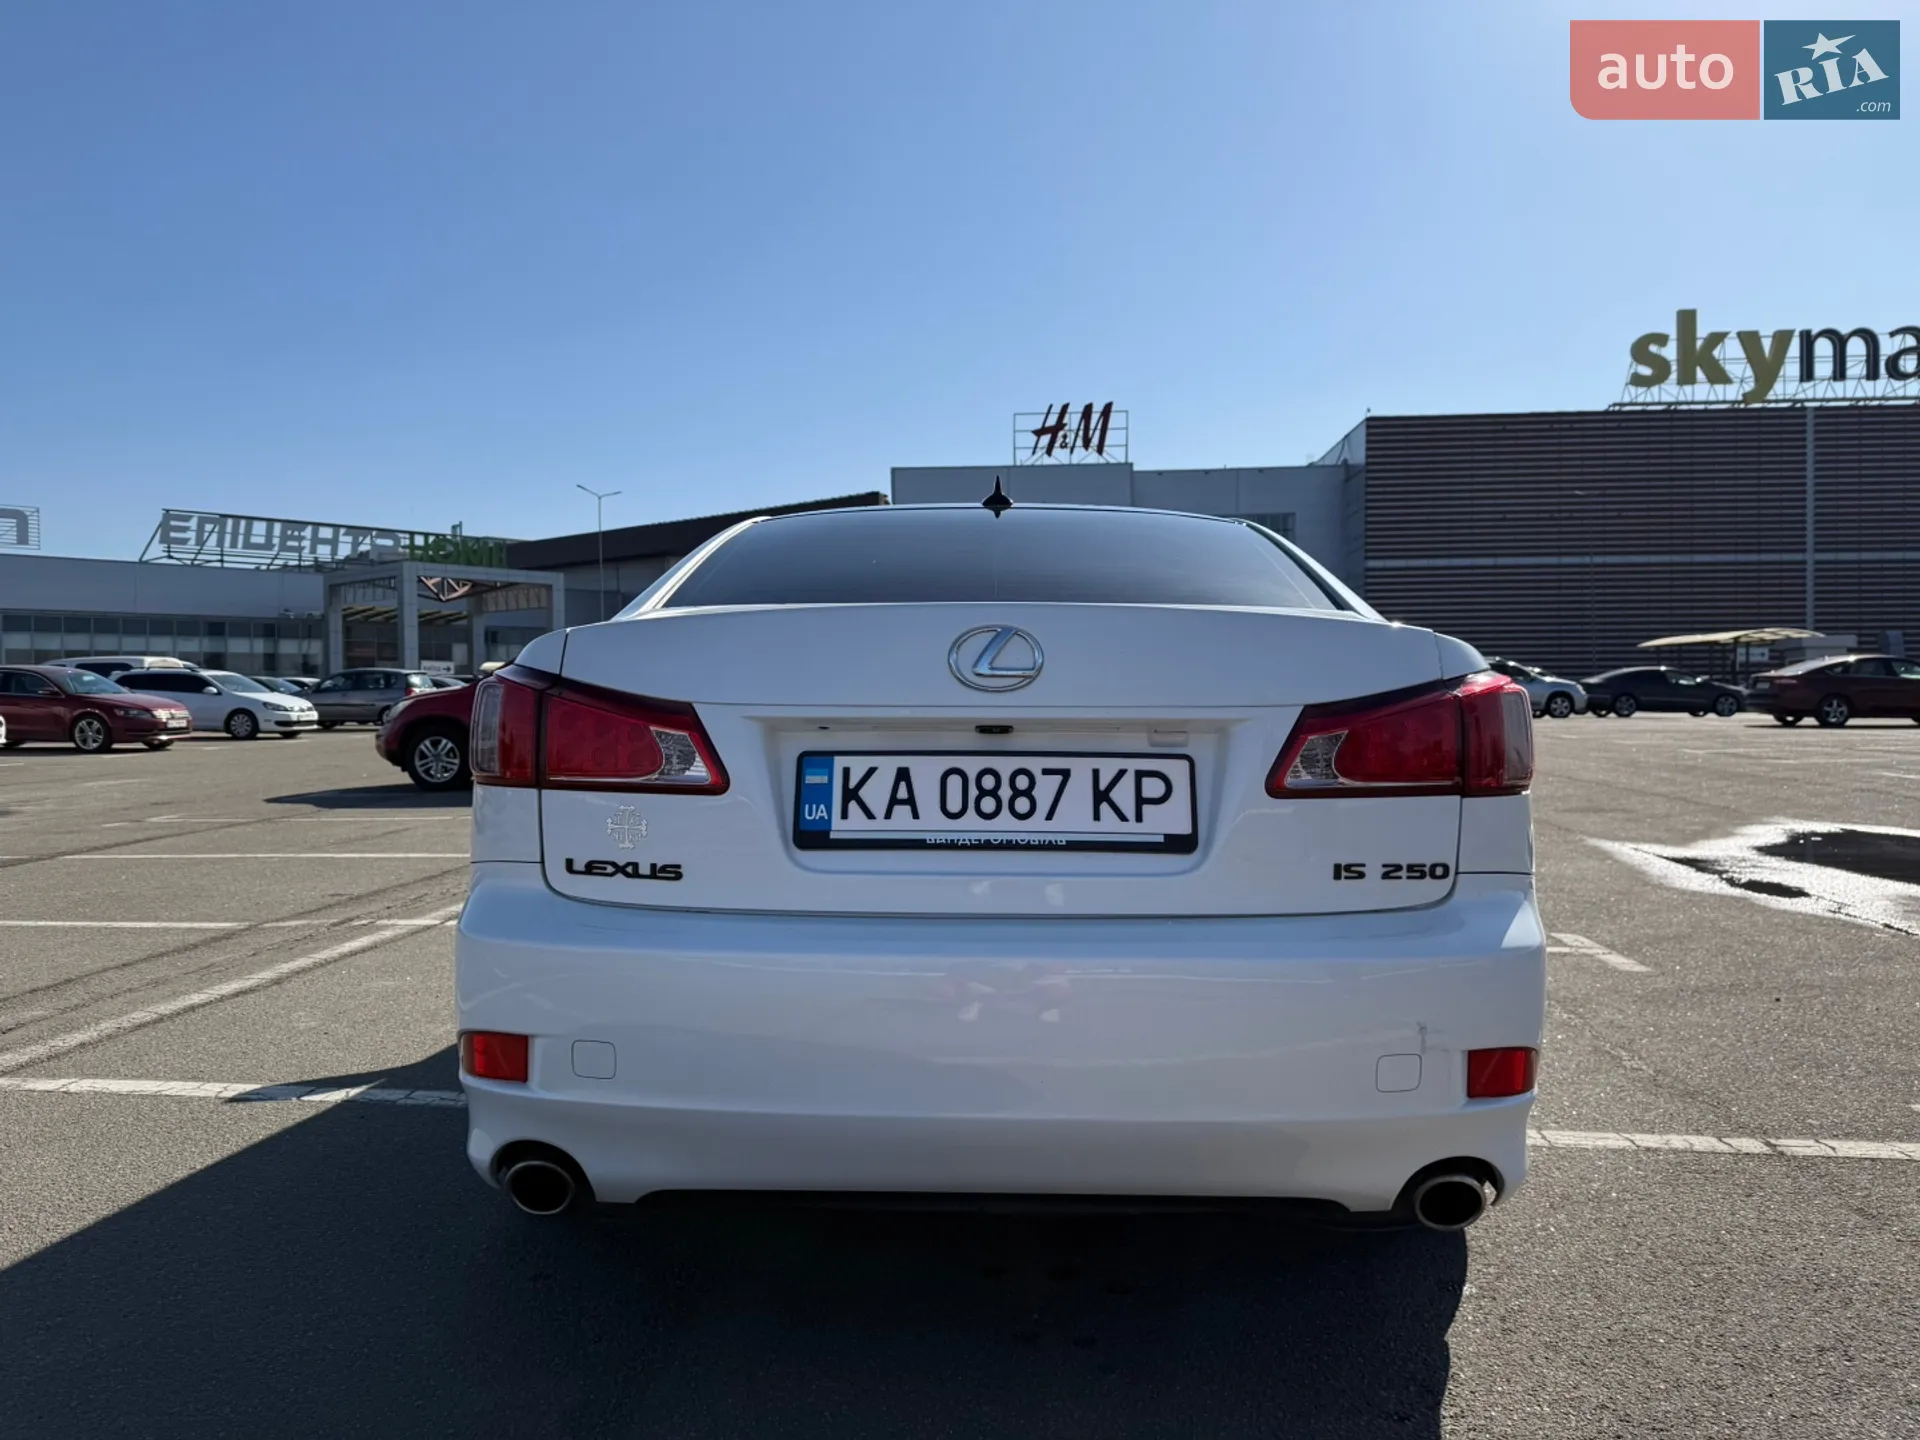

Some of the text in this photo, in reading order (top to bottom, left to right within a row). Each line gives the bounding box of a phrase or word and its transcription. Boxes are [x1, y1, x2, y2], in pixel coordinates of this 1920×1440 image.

[1031, 401, 1114, 457] H&M
[840, 766, 1173, 823] KA 0887 KP
[804, 803, 829, 820] UA
[565, 857, 684, 881] LEXUS
[1333, 862, 1450, 881] IS 250
